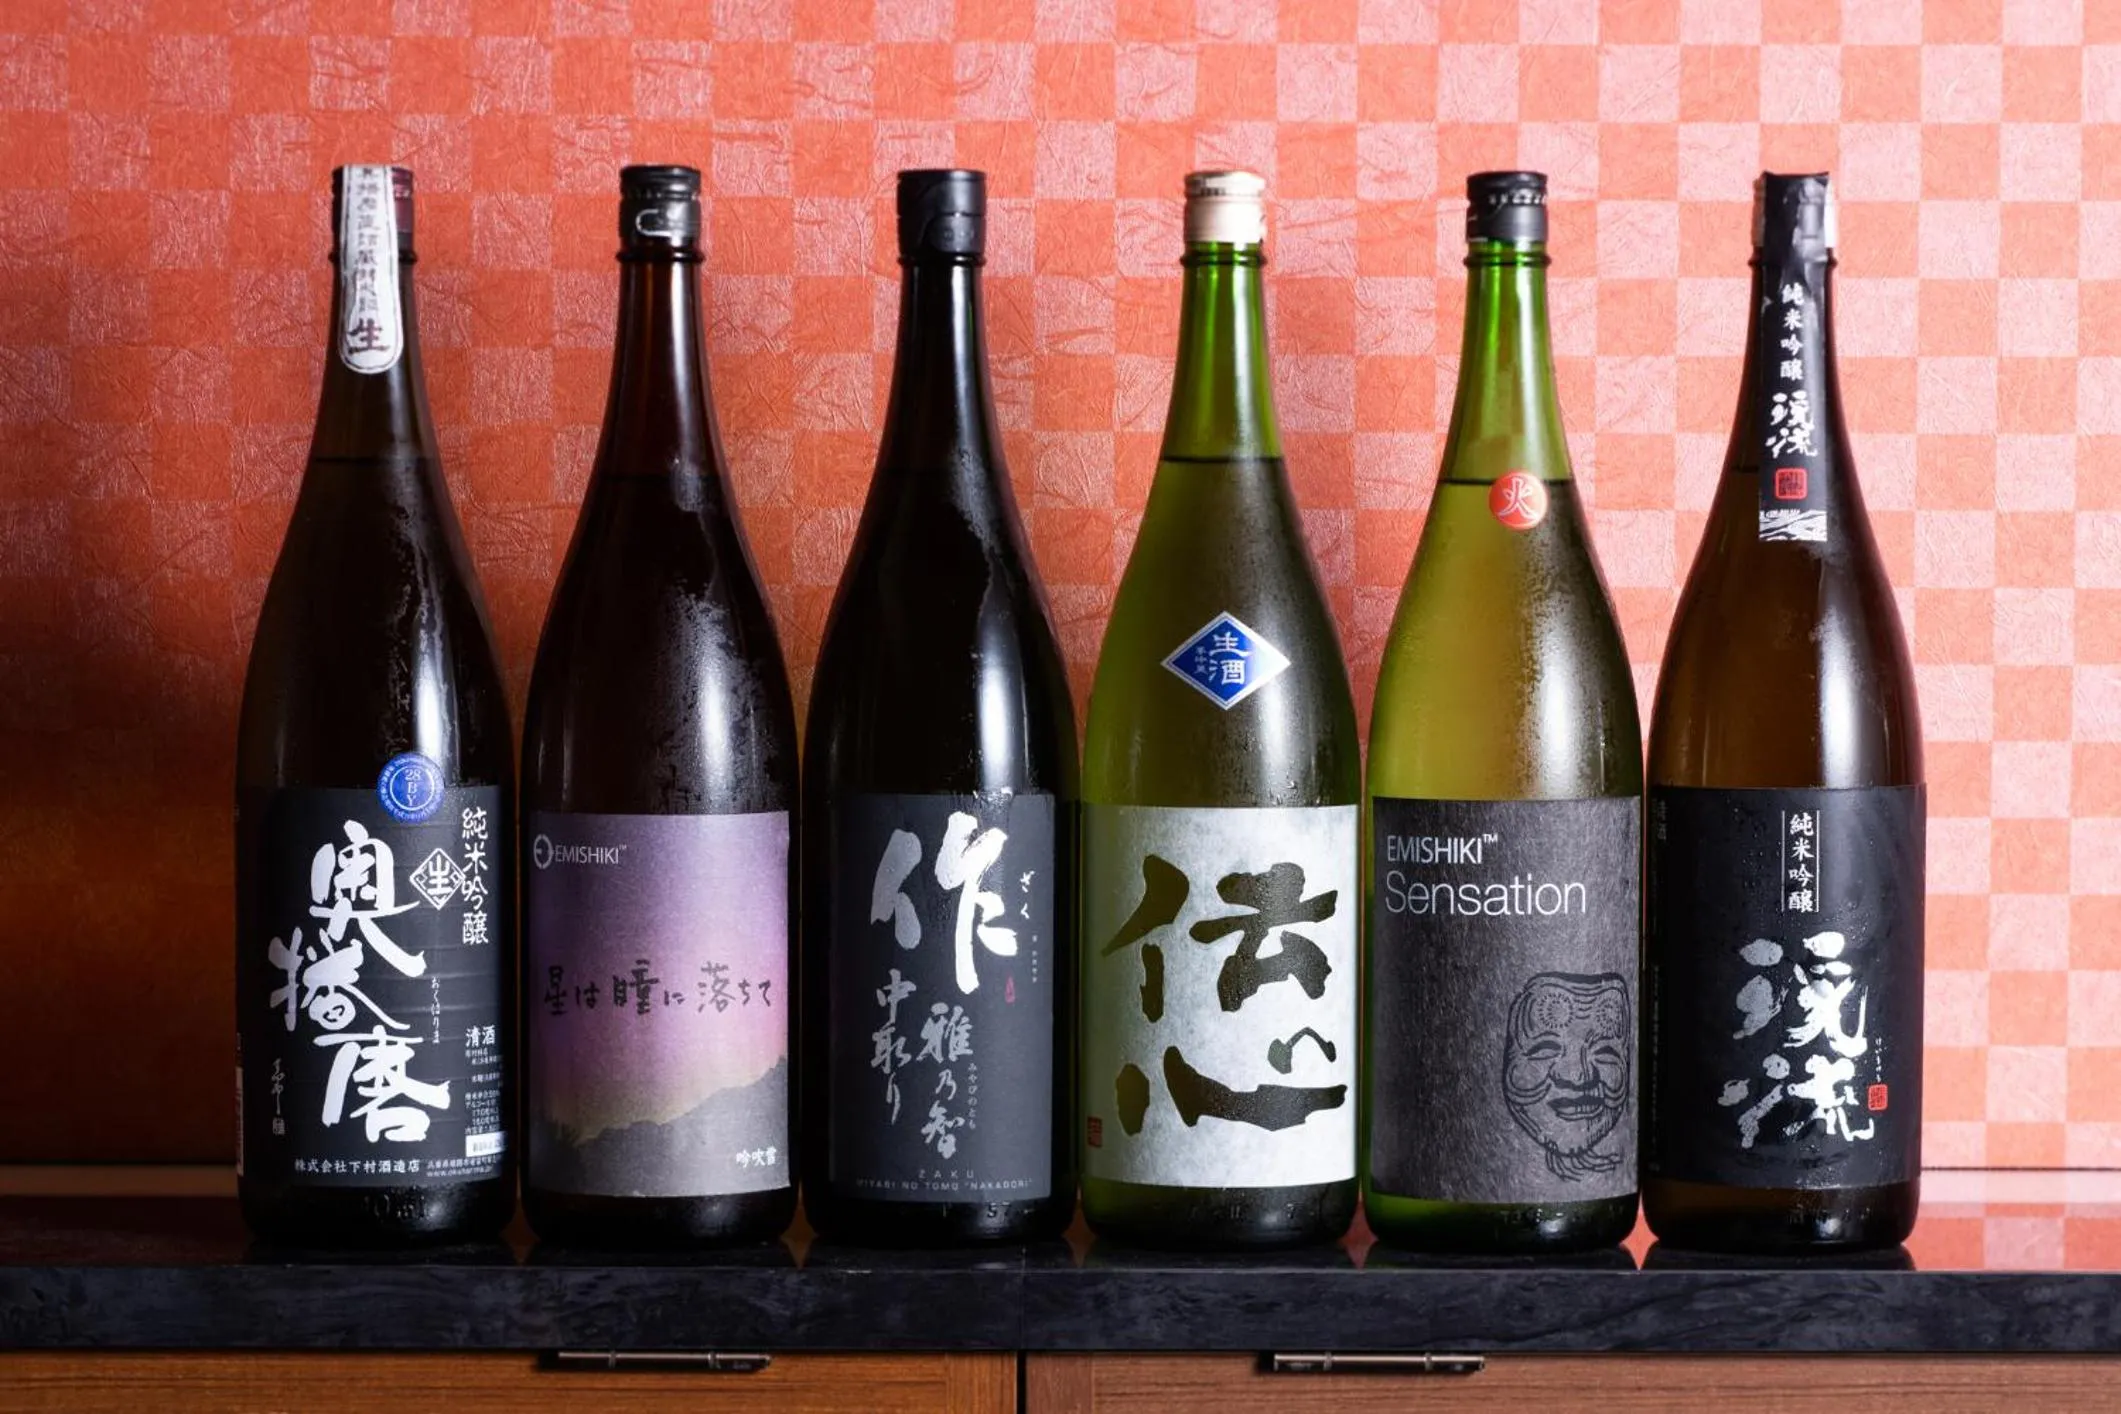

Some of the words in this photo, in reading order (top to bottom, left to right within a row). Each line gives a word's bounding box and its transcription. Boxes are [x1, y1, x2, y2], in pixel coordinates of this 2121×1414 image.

[347, 318, 390, 354] 生
[1779, 281, 1804, 381] 純米吟醸
[1497, 476, 1539, 520] 火
[1208, 631, 1253, 685] 生酒
[426, 853, 454, 897] 生
[461, 805, 490, 946] 純米吟醸
[1385, 869, 1587, 917] Sensation
[1788, 812, 1815, 913] 純米吟醸
[870, 811, 1018, 995] 作
[1019, 870, 1036, 920] ざく
[268, 819, 451, 1143] 奥播磨
[430, 975, 441, 1044] おくはりま
[1101, 854, 1348, 1137] 伝心
[465, 1024, 496, 1048] 清酒
[870, 968, 917, 1125] 中取り
[916, 1001, 974, 1160] 雅乃智
[967, 1061, 978, 1130] みやびのとも
[735, 1145, 777, 1169] 吟吹雪
[901, 1180, 919, 1191] NO
[925, 1181, 960, 1192] TOMO
[918, 1168, 975, 1180] ZAKU
